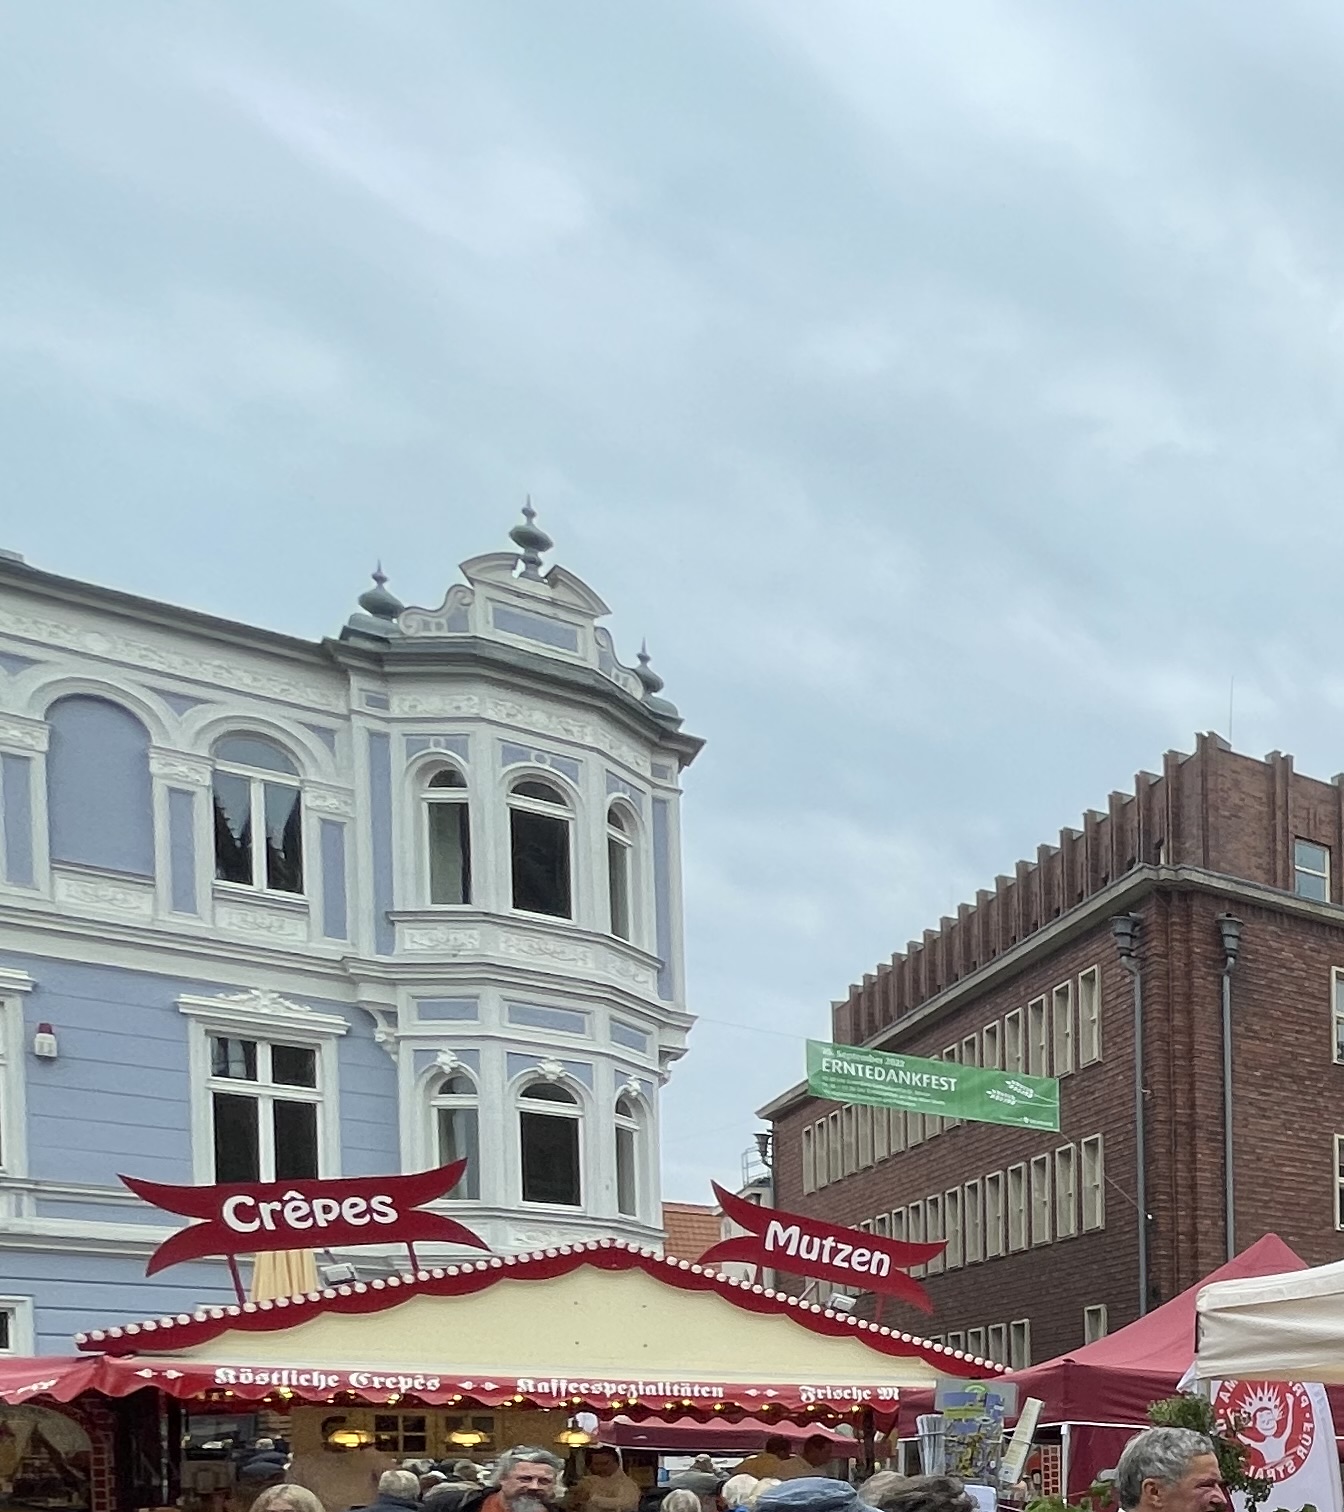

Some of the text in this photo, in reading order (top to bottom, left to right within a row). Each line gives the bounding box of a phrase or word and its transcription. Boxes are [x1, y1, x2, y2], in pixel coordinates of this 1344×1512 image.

[822, 1058, 957, 1092] ERNTEDANKFEST
[222, 1190, 399, 1233] Crêpes
[764, 1220, 892, 1277] Mutzen
[214, 1367, 339, 1391] Köstliche
[516, 1378, 724, 1398] Kaffeespezialitäten
[799, 1385, 872, 1403] Frische
